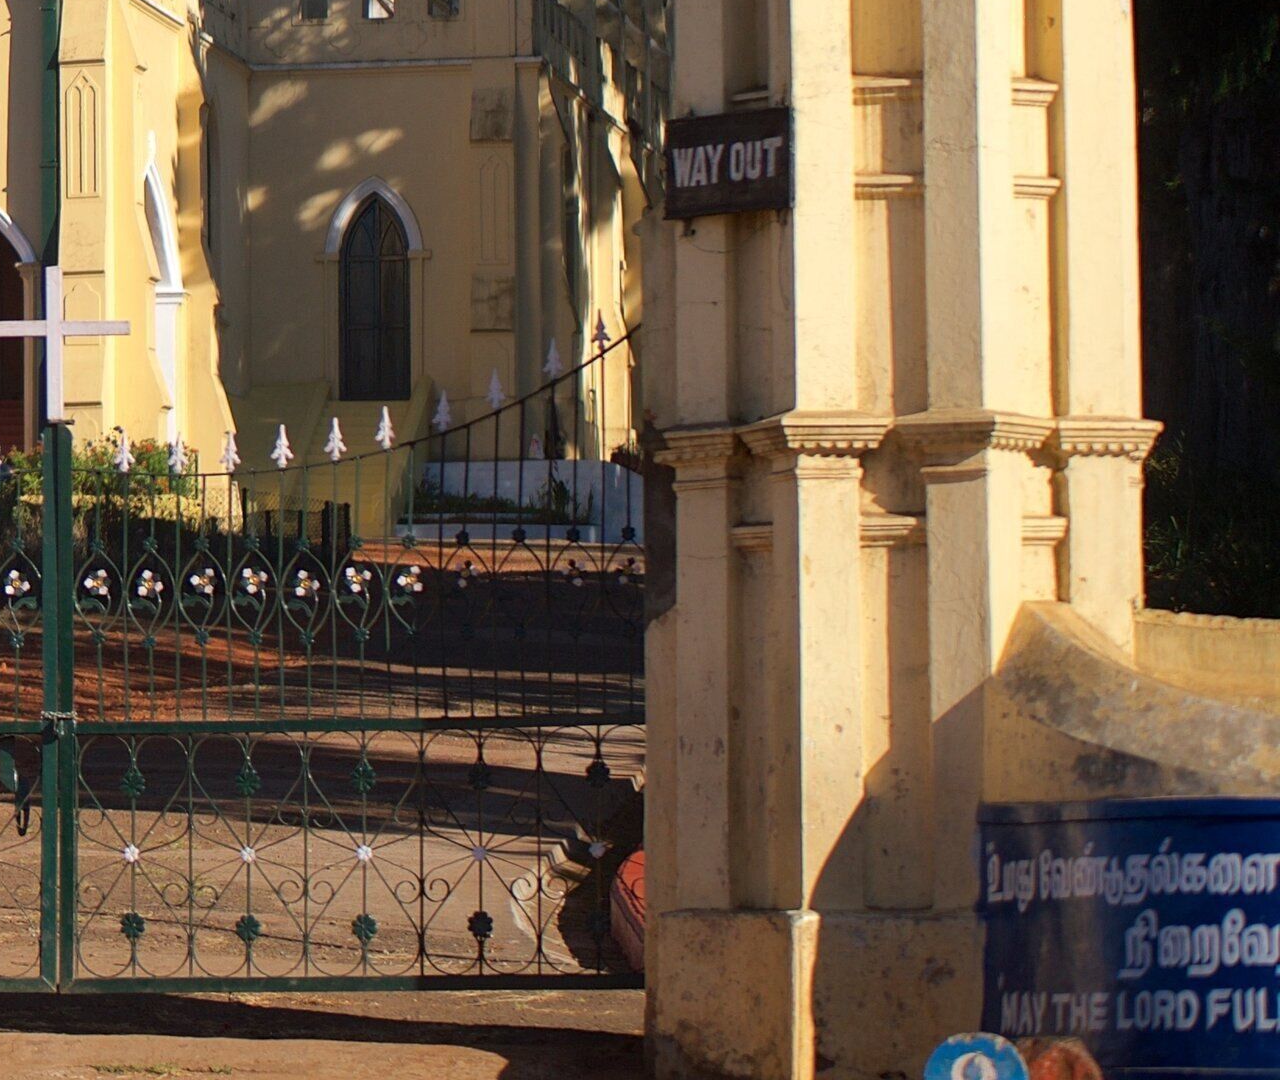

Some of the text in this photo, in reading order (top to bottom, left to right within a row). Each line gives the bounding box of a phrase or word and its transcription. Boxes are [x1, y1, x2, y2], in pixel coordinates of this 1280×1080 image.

[672, 136, 782, 188] WAY OUT
[1050, 991, 1110, 1032] THE
[1116, 989, 1200, 1030] LORD
[1206, 987, 1280, 1032] FUL
